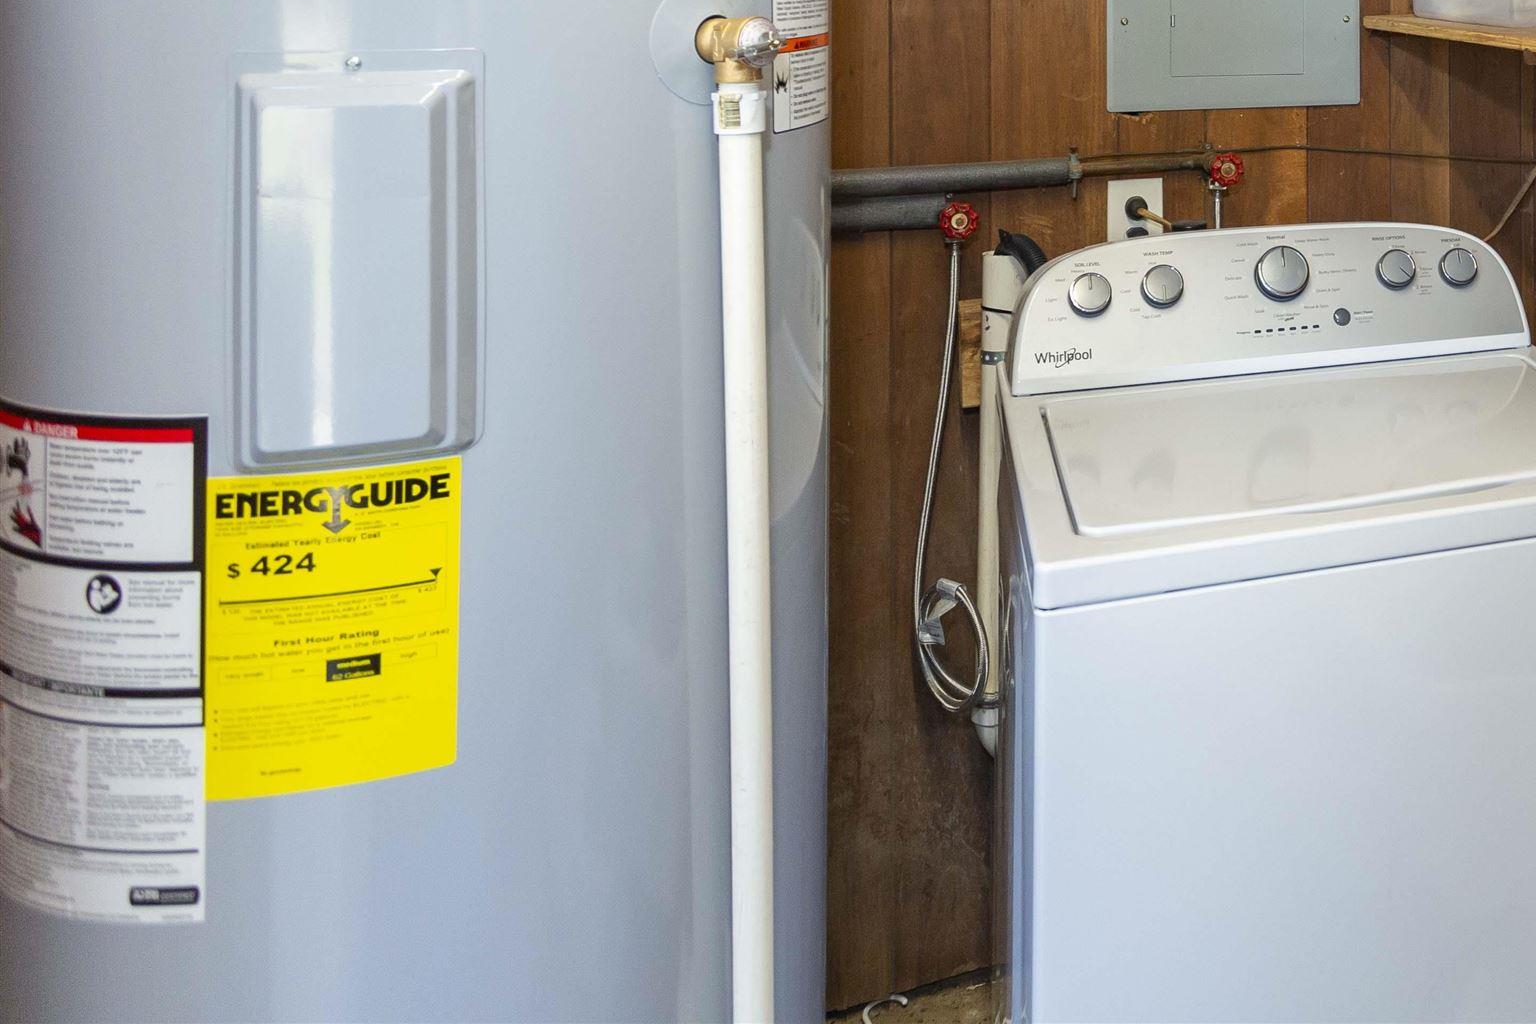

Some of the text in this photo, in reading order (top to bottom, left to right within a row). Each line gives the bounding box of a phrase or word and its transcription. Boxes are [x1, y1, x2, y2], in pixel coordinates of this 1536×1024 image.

[1034, 347, 1092, 368] Whirlpool
[34, 421, 78, 439] DANGER
[245, 532, 381, 551] Estimated Yearly Energy Cost
[227, 551, 316, 579] $ 424
[273, 629, 380, 648] First Hour Rating
